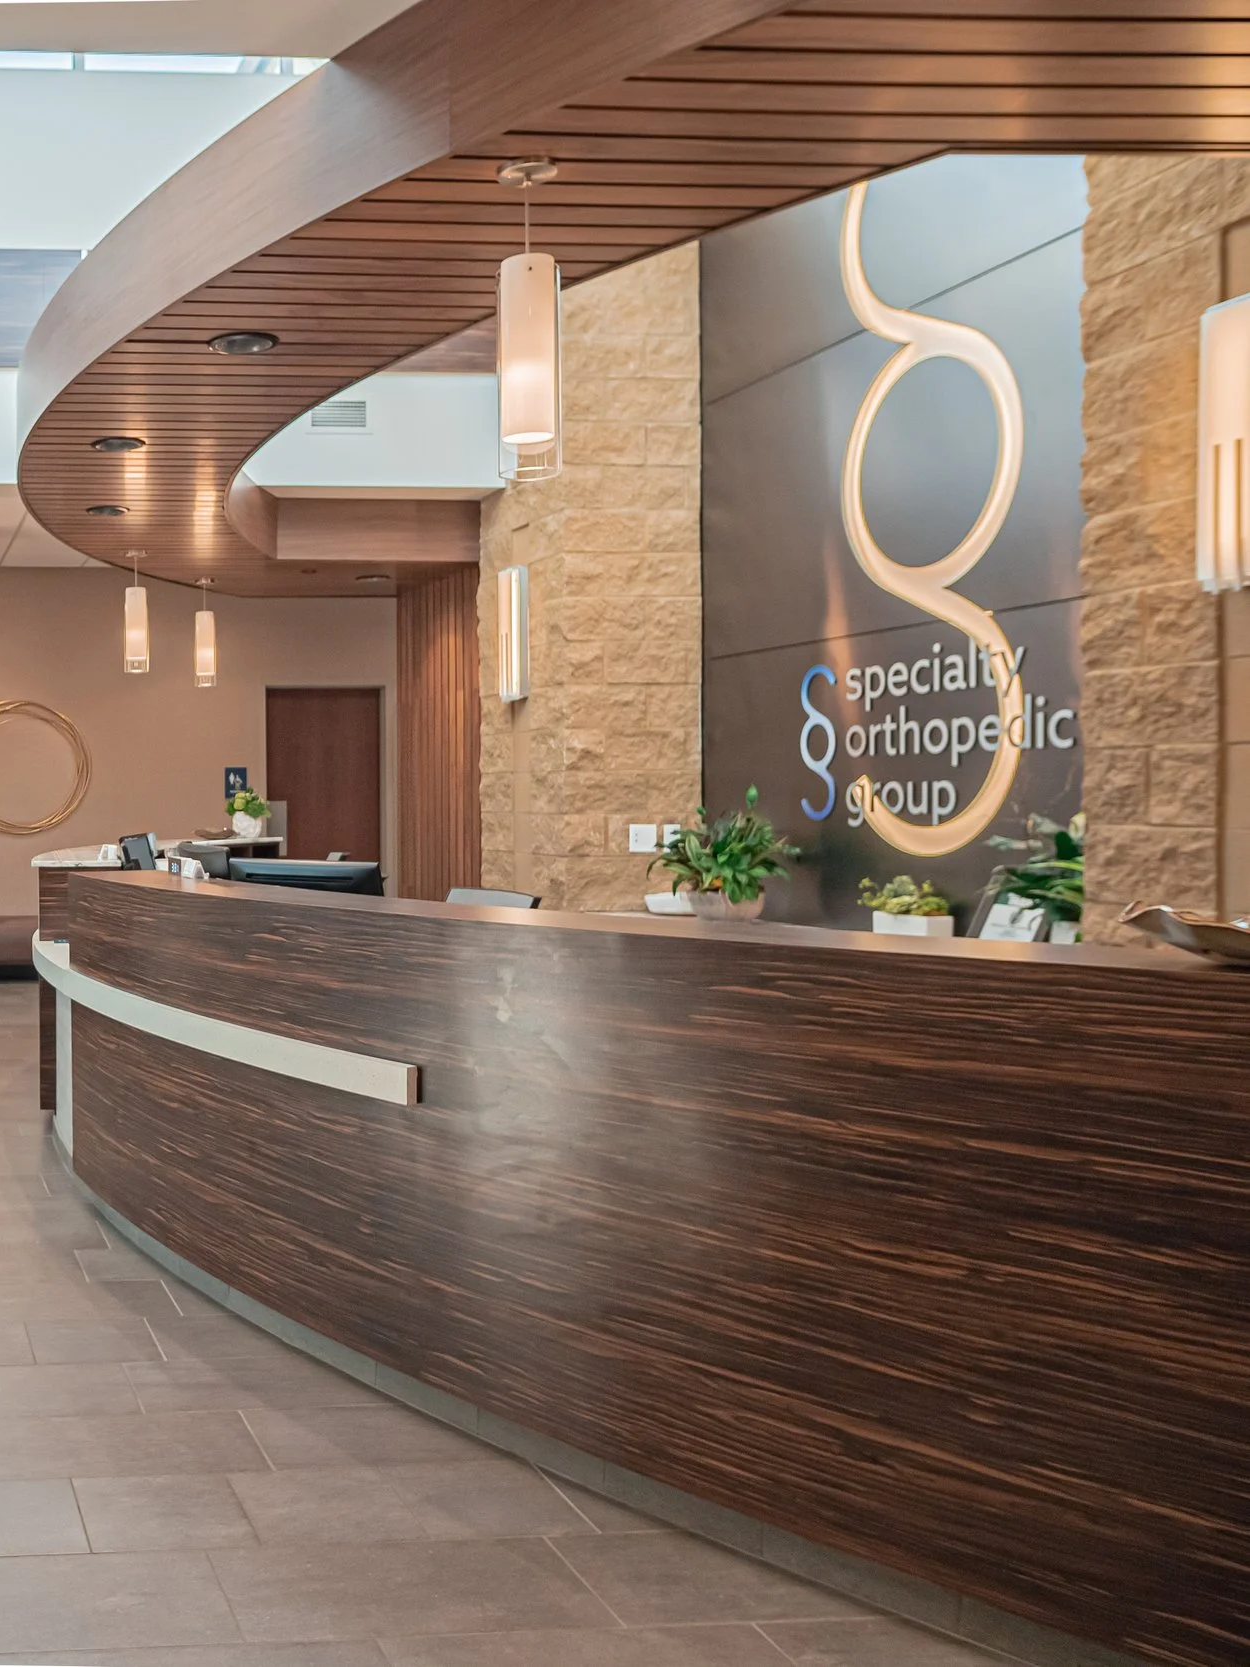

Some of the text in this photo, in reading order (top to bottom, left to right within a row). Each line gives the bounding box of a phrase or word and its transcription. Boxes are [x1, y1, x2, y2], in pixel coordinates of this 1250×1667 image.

[845, 637, 1025, 712] specialty
[845, 693, 1075, 767] orthopedic
[845, 780, 956, 828] group
